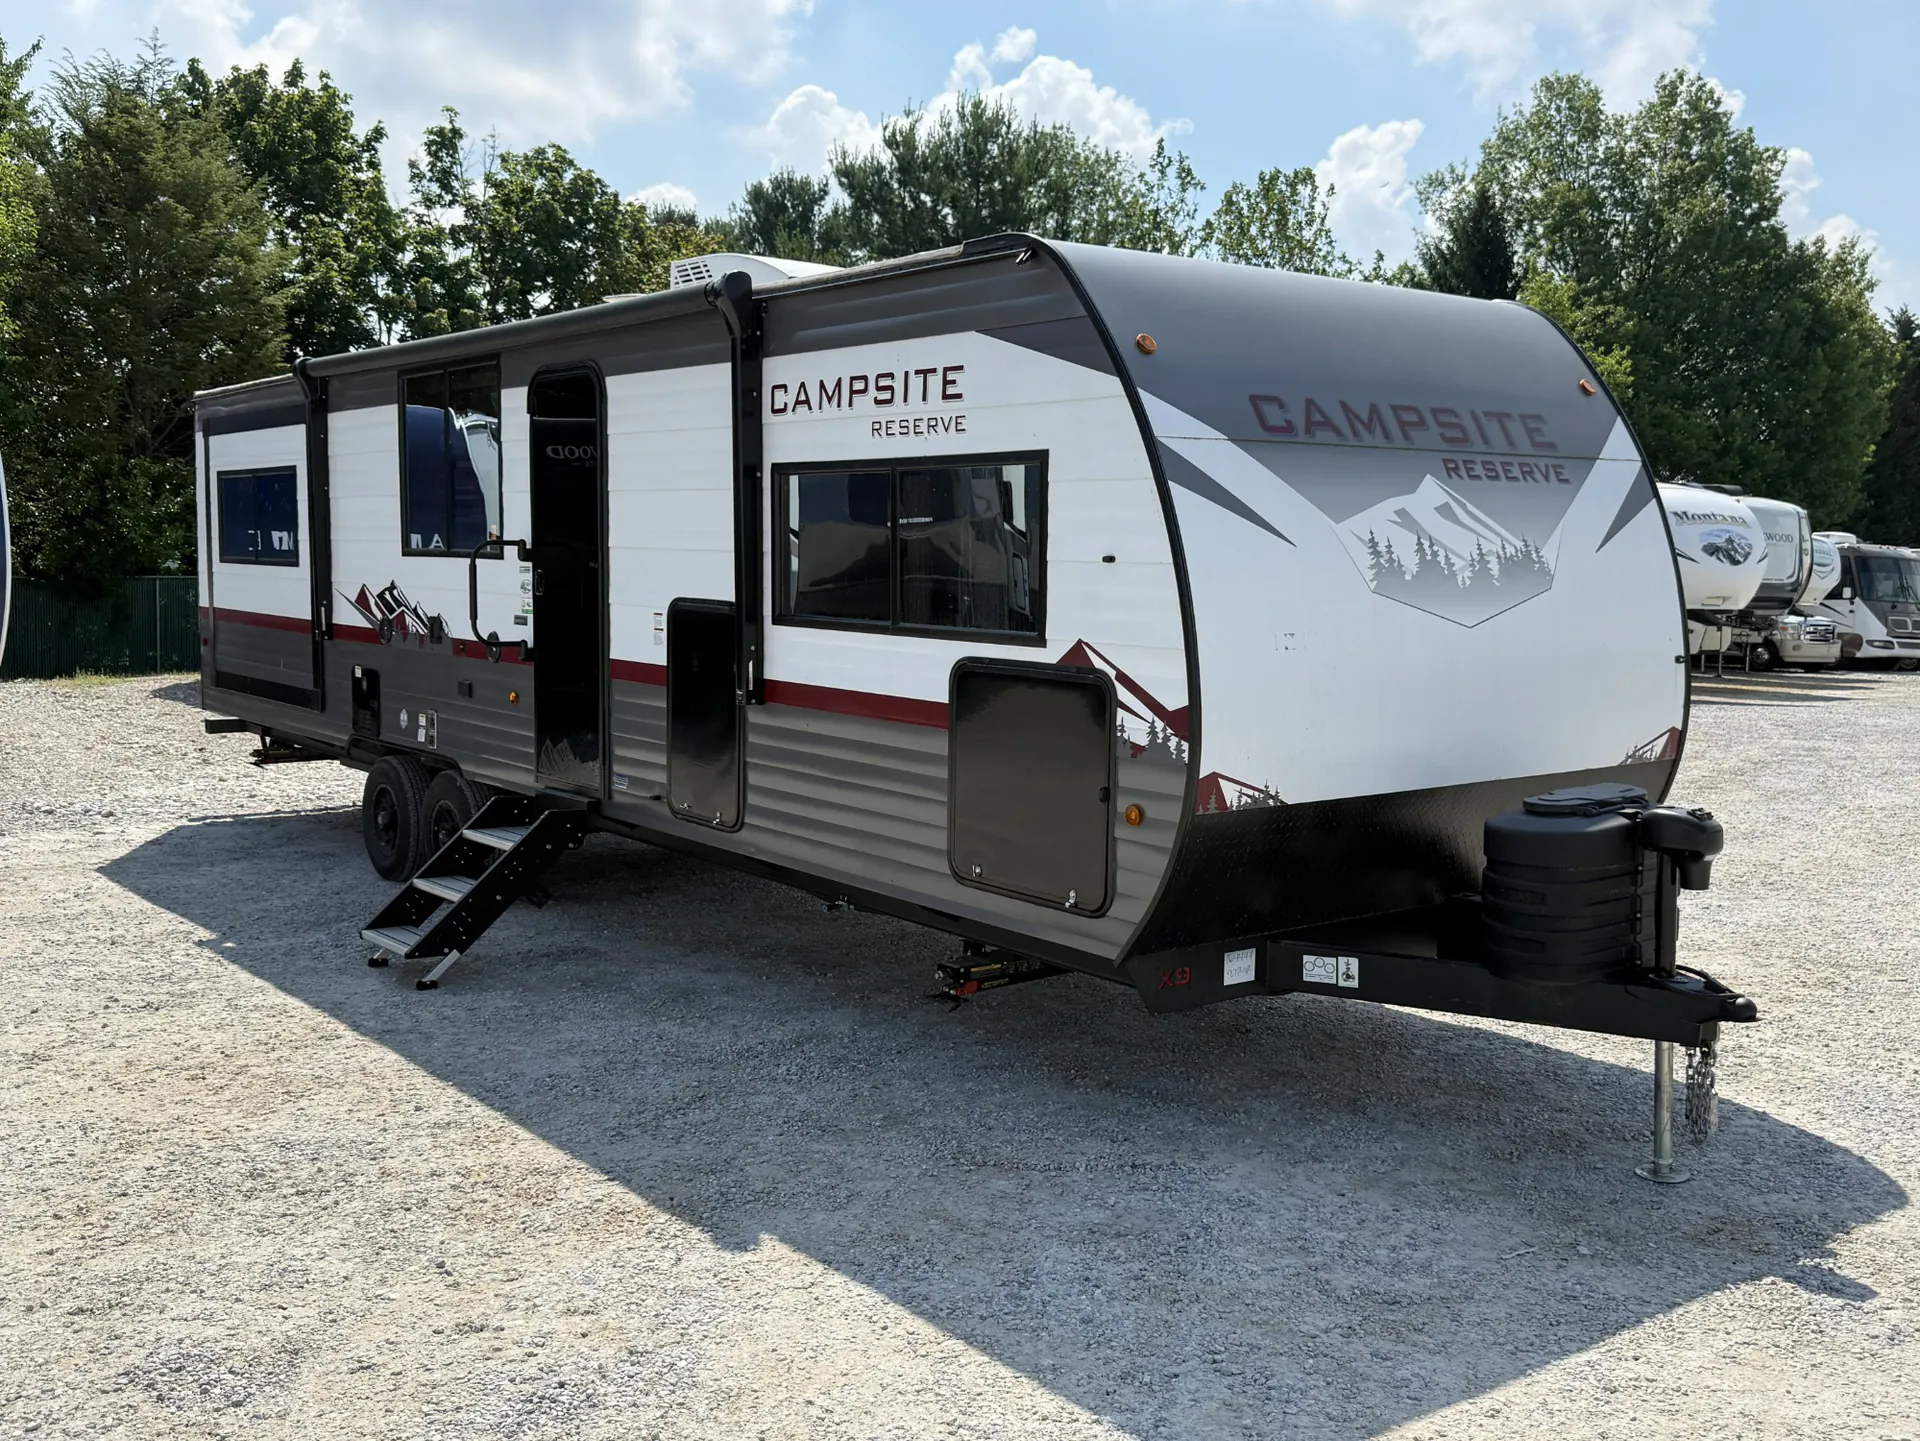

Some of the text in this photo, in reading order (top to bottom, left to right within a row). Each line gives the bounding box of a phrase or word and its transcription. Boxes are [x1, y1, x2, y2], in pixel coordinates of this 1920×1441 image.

[770, 365, 965, 416] CAMPSITE
[871, 414, 968, 439] RESERVE
[1248, 394, 1558, 450] CAMPSITE
[1441, 457, 1571, 485] RESERVE
[1670, 511, 1748, 525] Montana
[1763, 532, 1793, 543] WOOD
